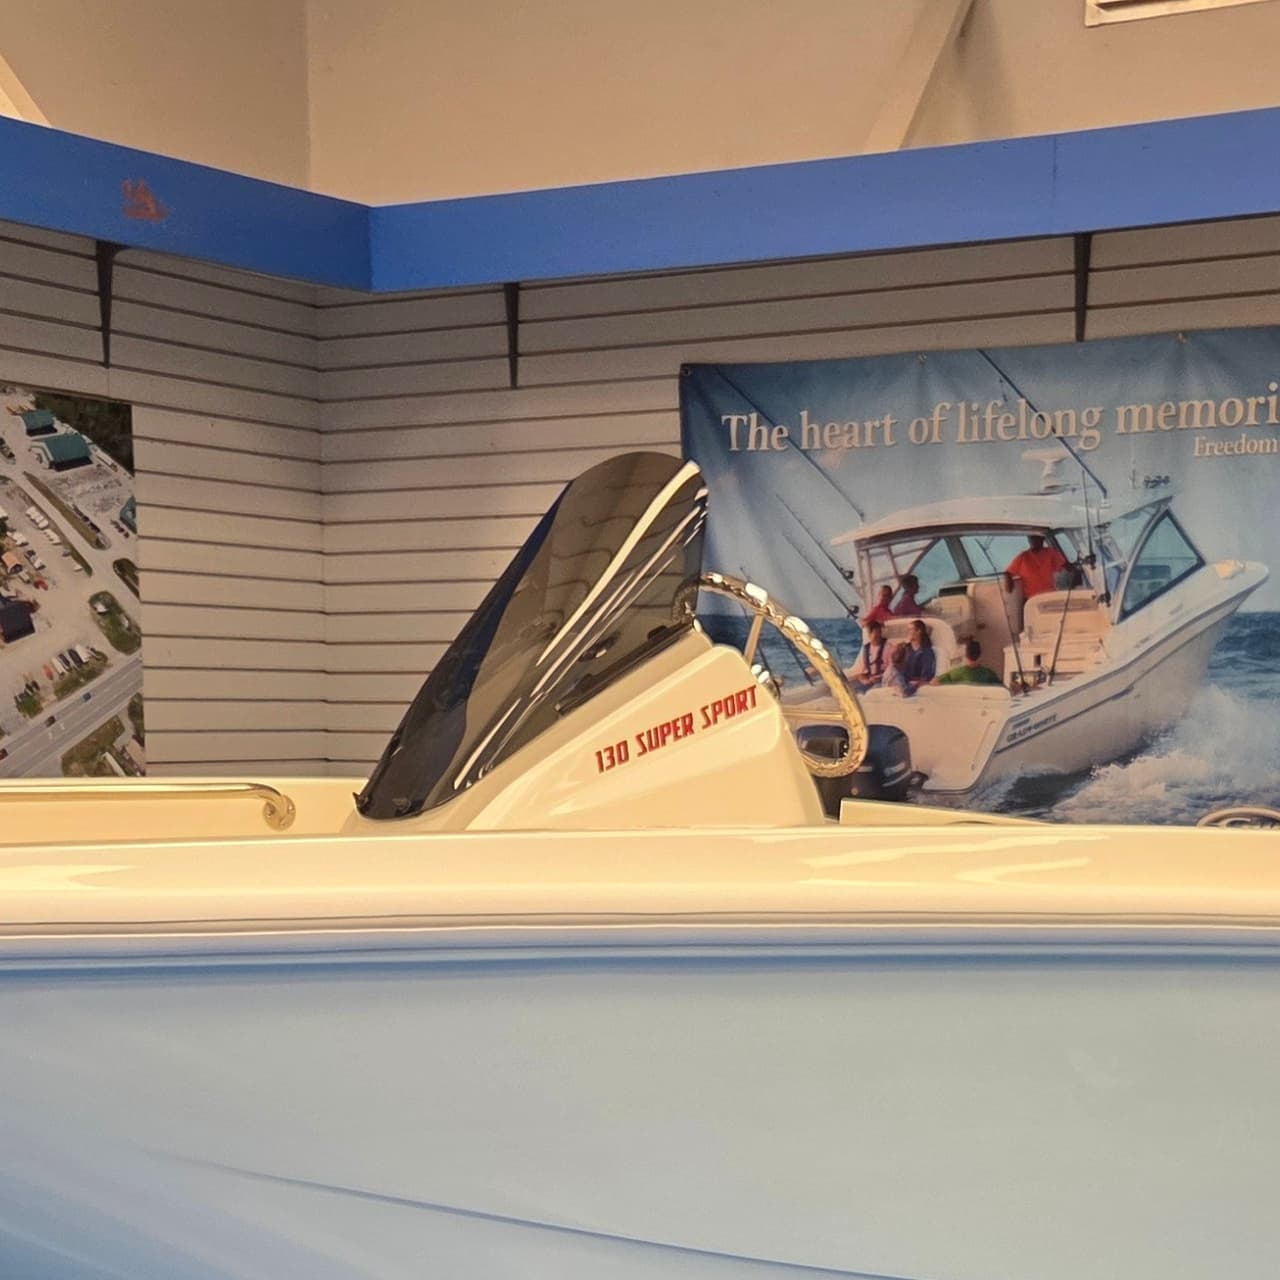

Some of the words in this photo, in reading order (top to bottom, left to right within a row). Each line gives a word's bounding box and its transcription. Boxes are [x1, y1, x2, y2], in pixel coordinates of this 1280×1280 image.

[721, 412, 789, 451] The
[799, 410, 897, 451] heart
[908, 402, 952, 446] of
[955, 398, 1105, 450] lifelong
[1193, 432, 1278, 457] Freedom
[595, 740, 630, 774] 130
[635, 712, 696, 758] SUPER
[699, 684, 757, 730] SPORT
